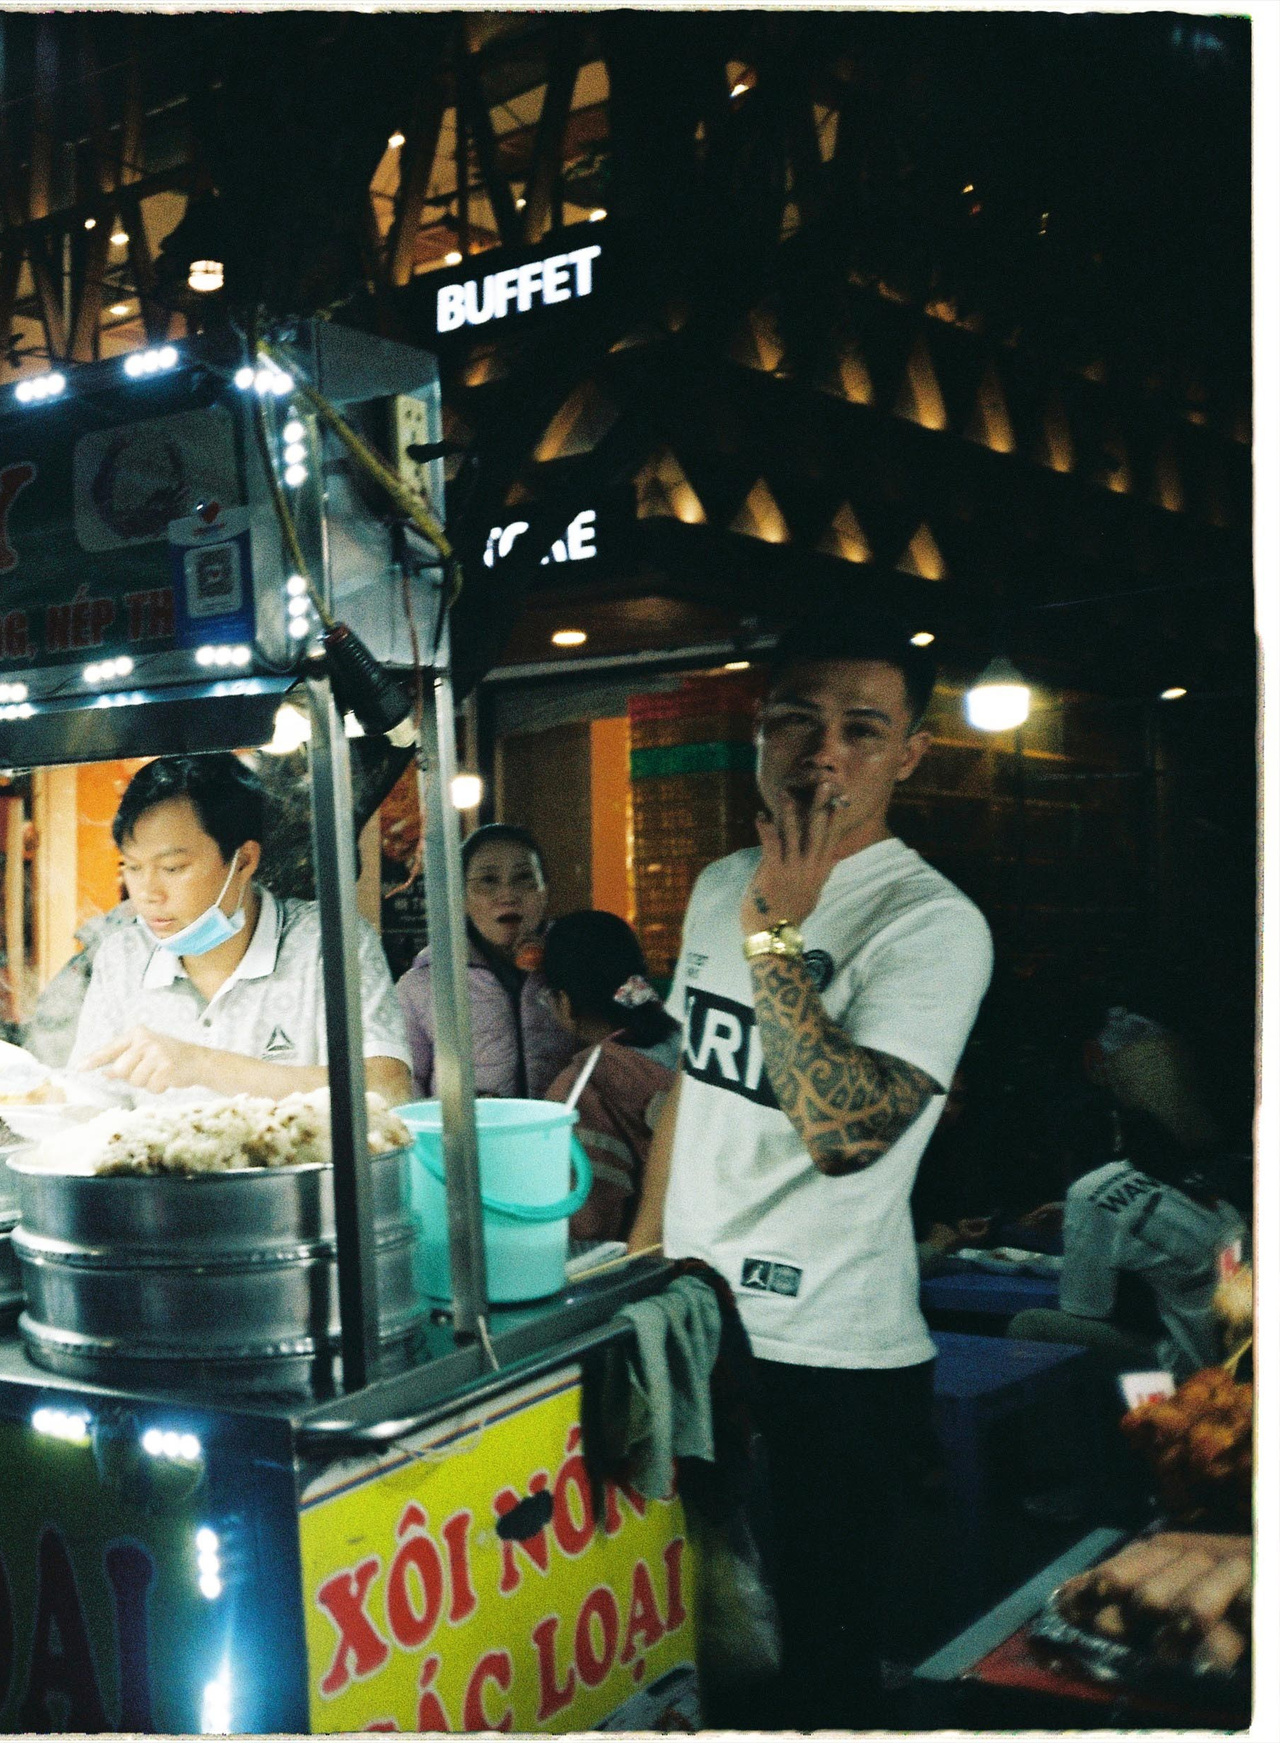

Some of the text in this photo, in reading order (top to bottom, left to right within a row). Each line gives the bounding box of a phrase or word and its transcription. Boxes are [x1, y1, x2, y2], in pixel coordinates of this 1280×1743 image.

[436, 245, 601, 332] BUFFET
[317, 1500, 478, 1697] XÔI
[531, 1535, 687, 1722] LOẠI
